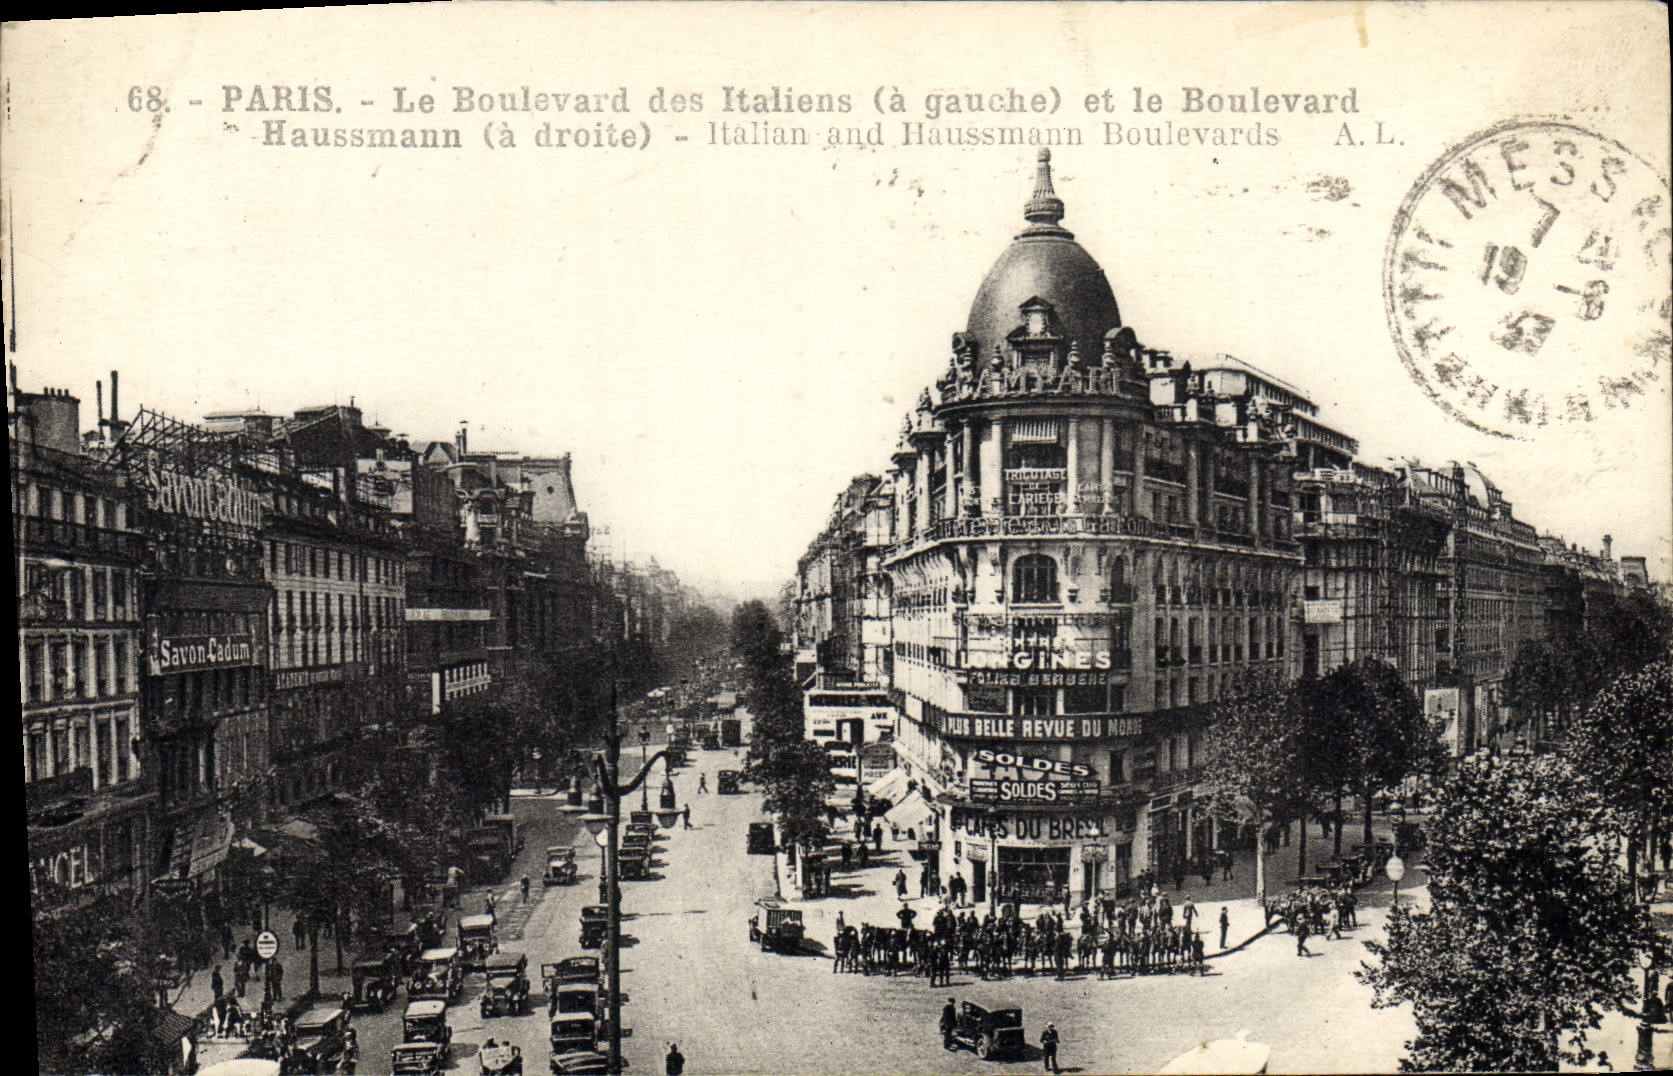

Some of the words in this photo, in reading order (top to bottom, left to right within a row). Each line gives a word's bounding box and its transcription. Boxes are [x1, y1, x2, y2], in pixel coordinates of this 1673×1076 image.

[161, 640, 206, 667] Savon
[208, 637, 250, 662] Cadum
[960, 650, 1112, 671] LONGINES
[974, 718, 1015, 738] BELLE
[1022, 719, 1075, 739] REVUE
[1082, 719, 1102, 737] DU
[978, 749, 1091, 777] SOLDES
[1000, 781, 1056, 801] SOLDES
[1016, 815, 1042, 840] DU
